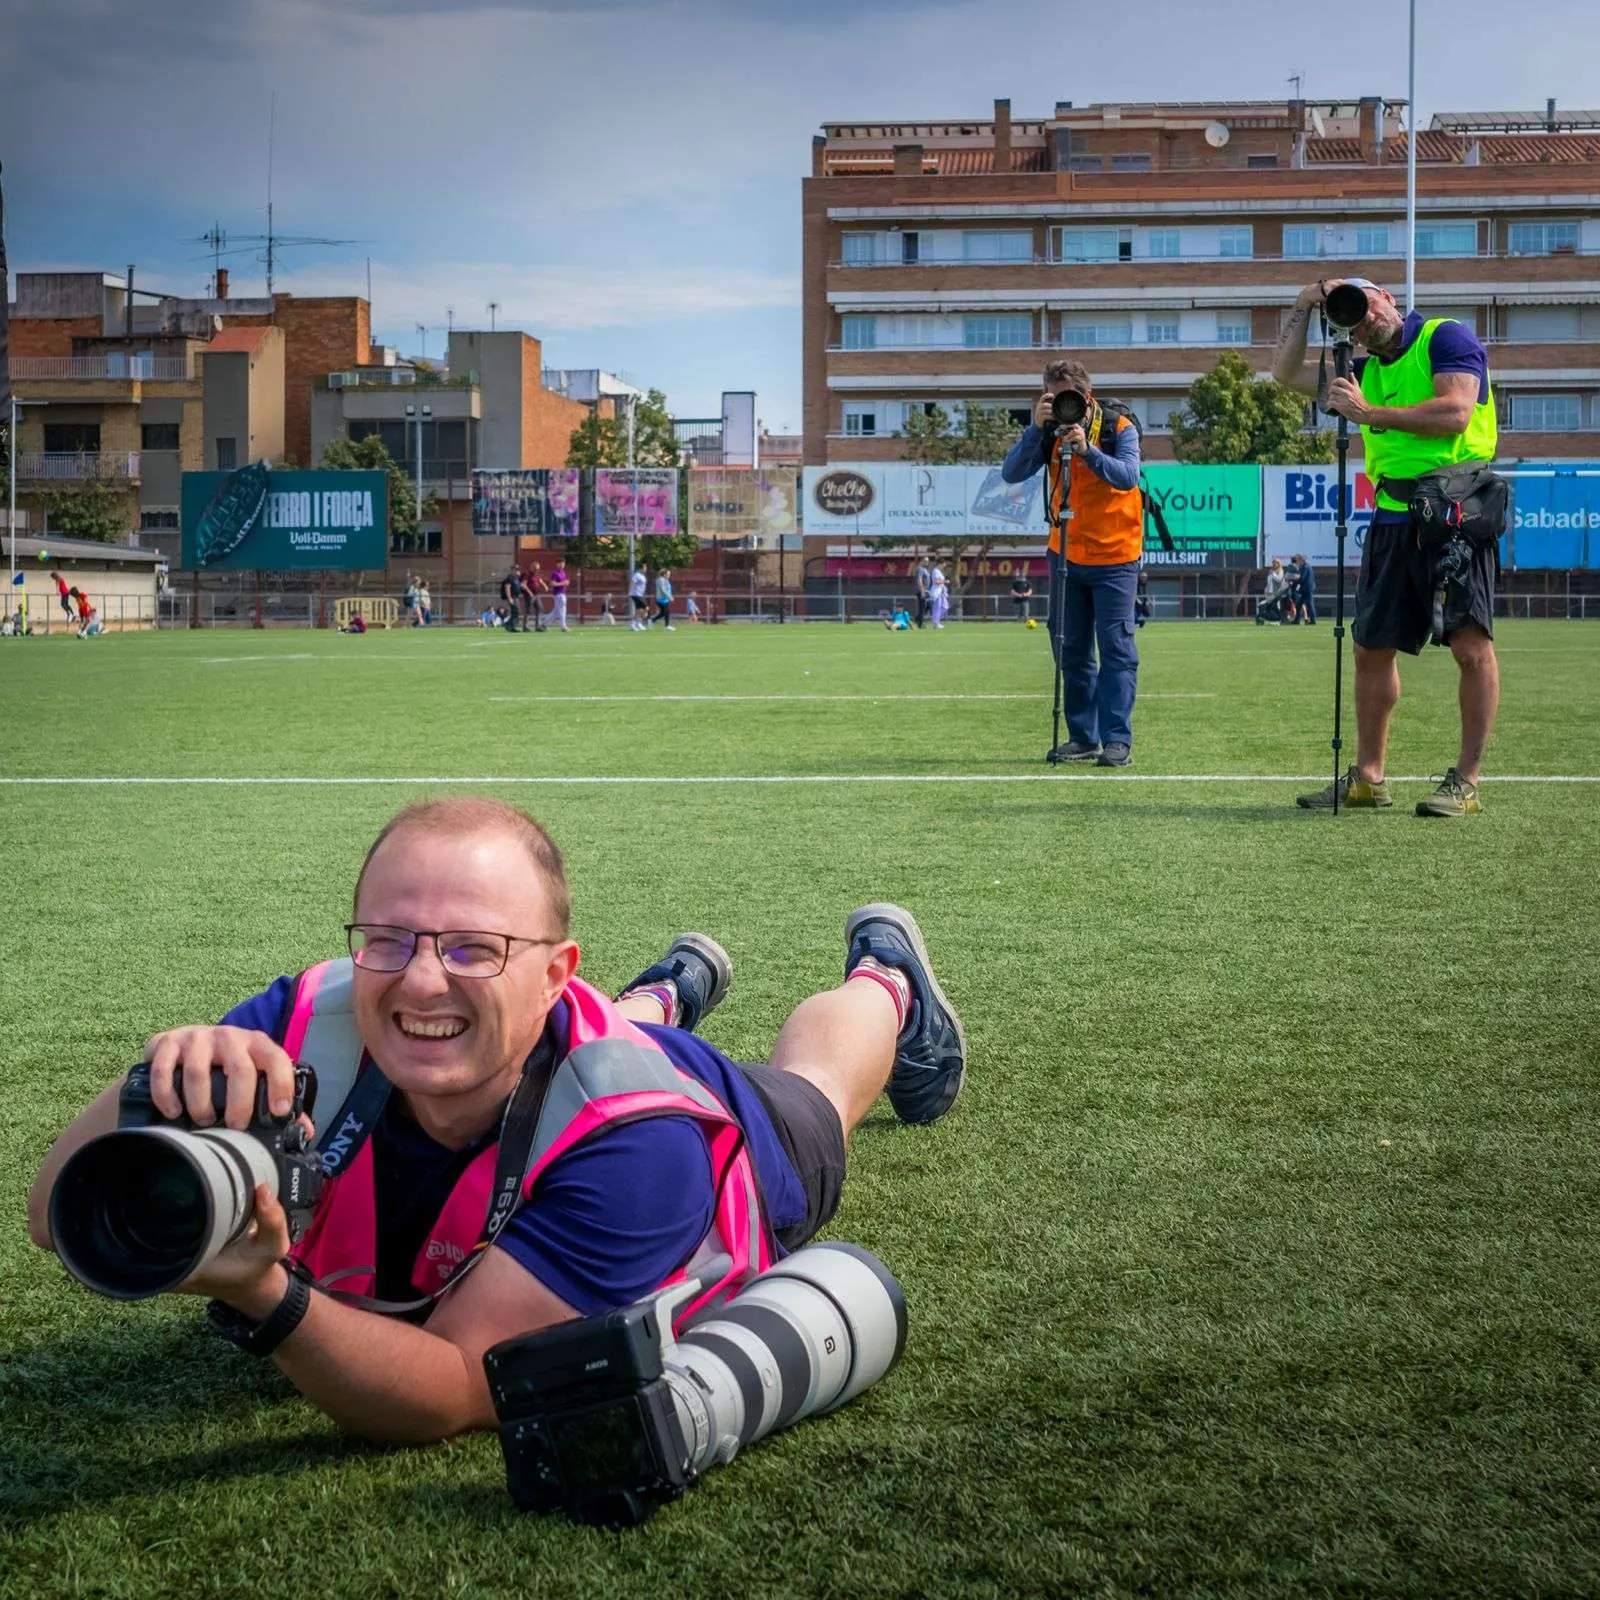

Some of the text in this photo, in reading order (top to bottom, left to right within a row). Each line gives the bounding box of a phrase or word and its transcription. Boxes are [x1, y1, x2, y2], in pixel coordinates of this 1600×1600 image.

[822, 479, 867, 497] CheChe
[1153, 487, 1233, 512] Youin
[262, 491, 311, 528] FERRO
[313, 491, 321, 528] I
[322, 490, 374, 532] FORÇA
[289, 531, 347, 544] Voll-Damm
[290, 1167, 301, 1202] SONY
